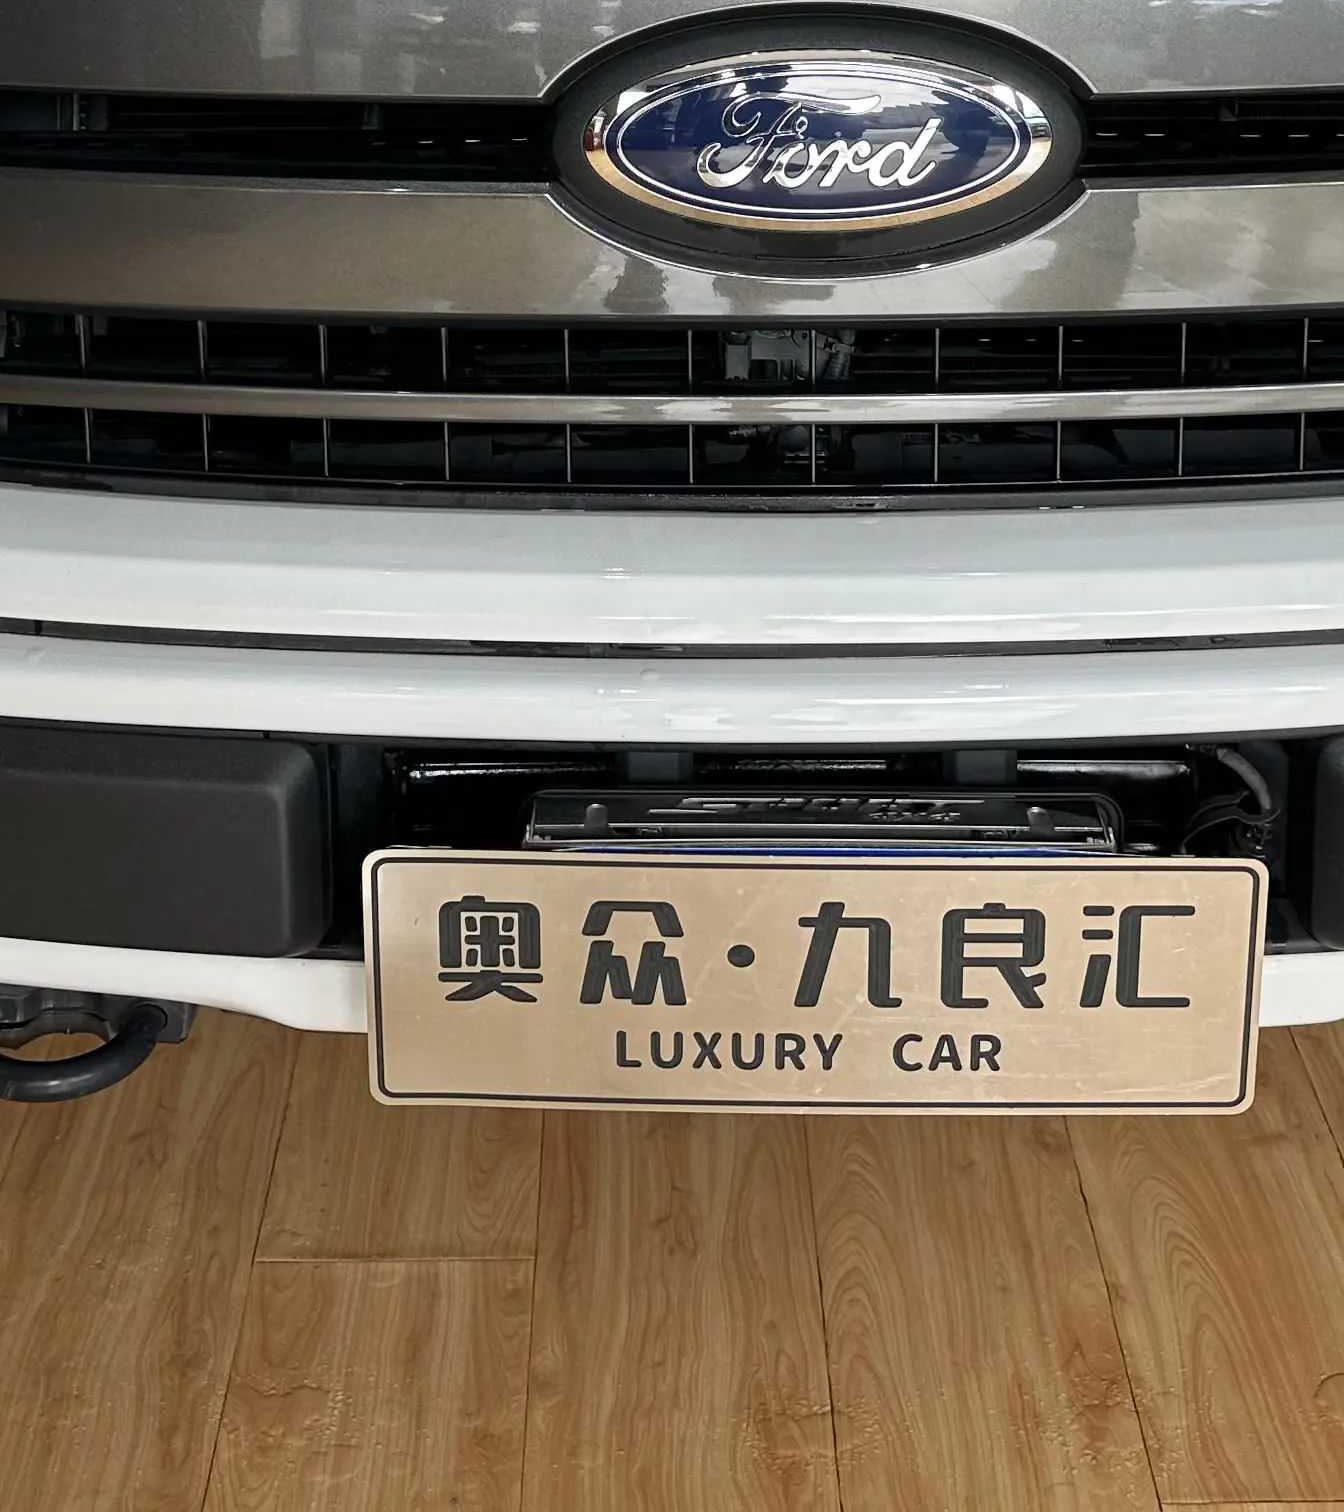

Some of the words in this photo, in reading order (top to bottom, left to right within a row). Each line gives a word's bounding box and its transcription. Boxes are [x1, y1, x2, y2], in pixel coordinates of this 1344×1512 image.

[696, 91, 943, 189] Ford
[437, 894, 1196, 1009] 奥众·九良汇
[616, 1029, 844, 1072] LUXURY
[892, 1033, 1002, 1072] CAR
